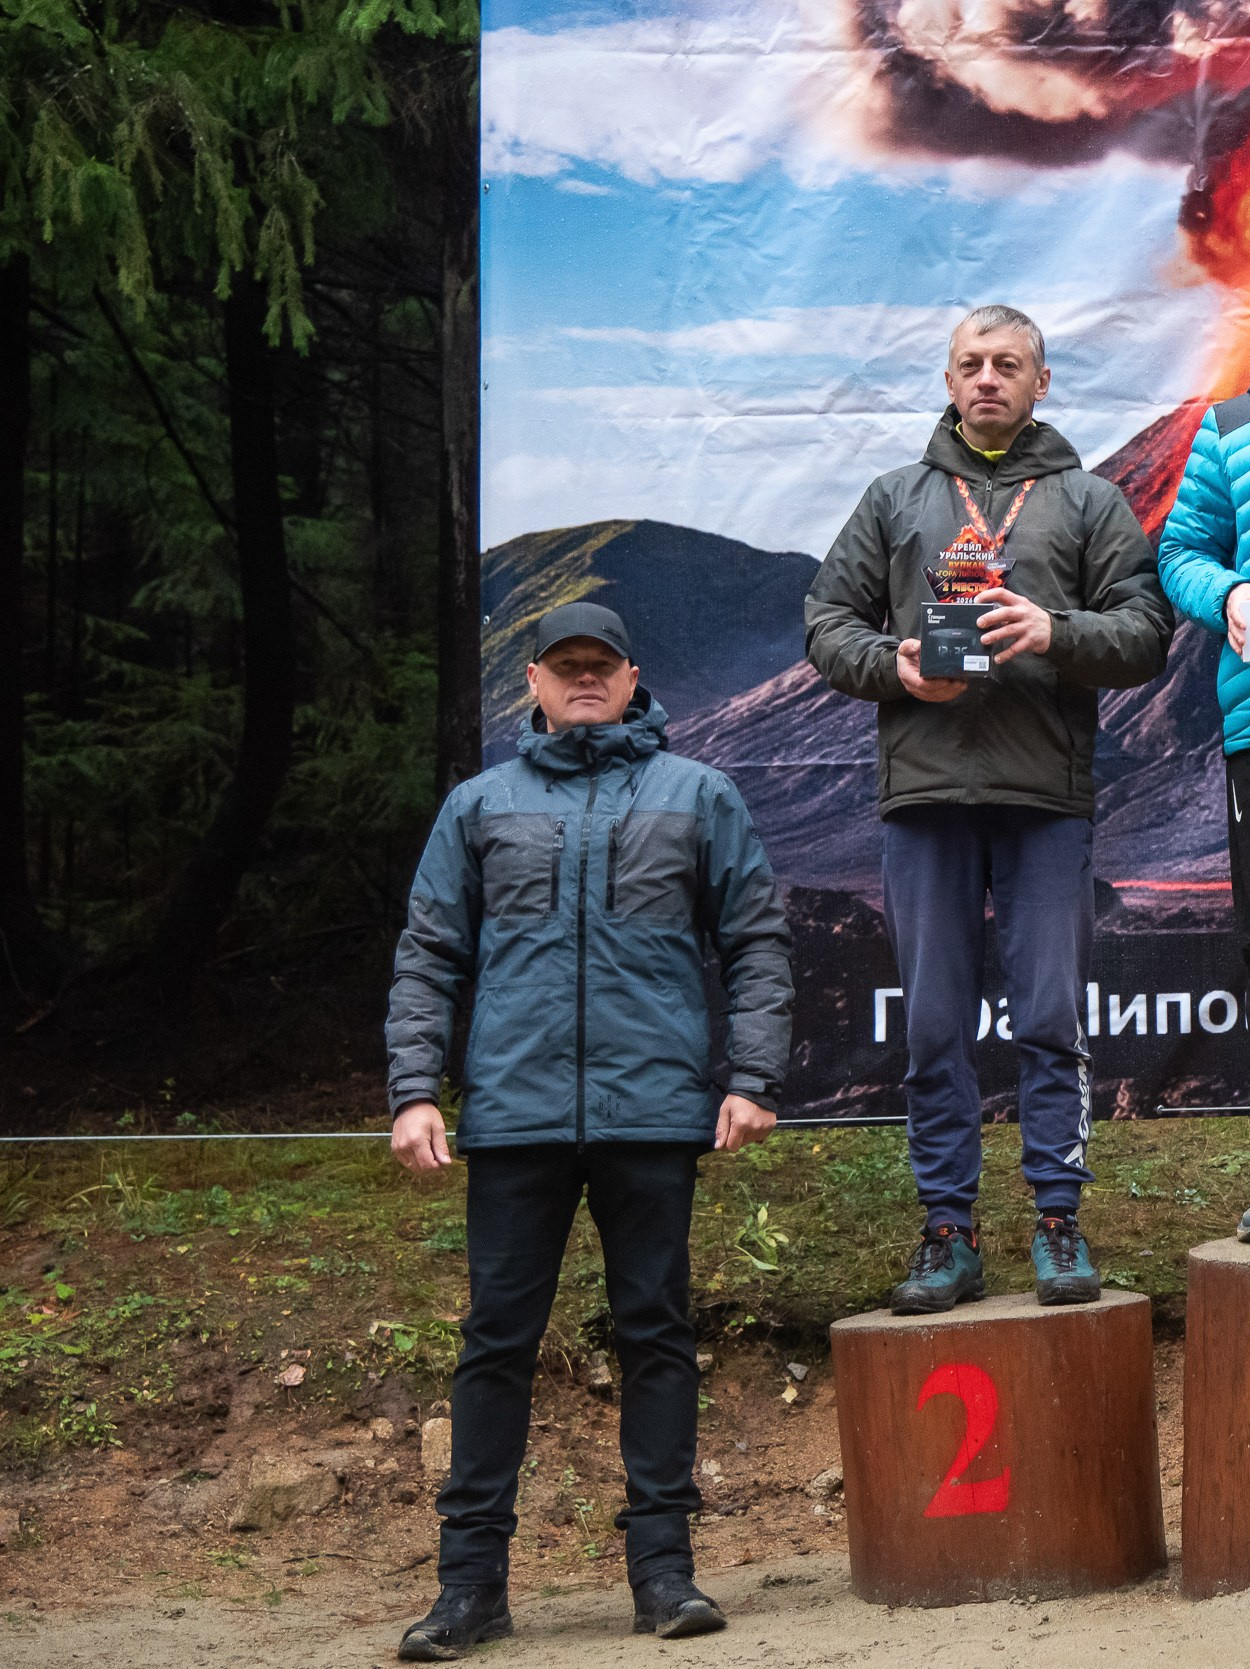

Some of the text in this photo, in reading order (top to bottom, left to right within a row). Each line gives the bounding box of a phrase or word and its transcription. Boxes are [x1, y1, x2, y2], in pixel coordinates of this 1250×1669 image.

[952, 542, 982, 552] ТРЕЙЛ
[939, 550, 995, 560] УРАЛЬСКИЙ
[942, 582, 989, 592] 2 МЕСТО
[916, 1363, 1011, 1518] 2
